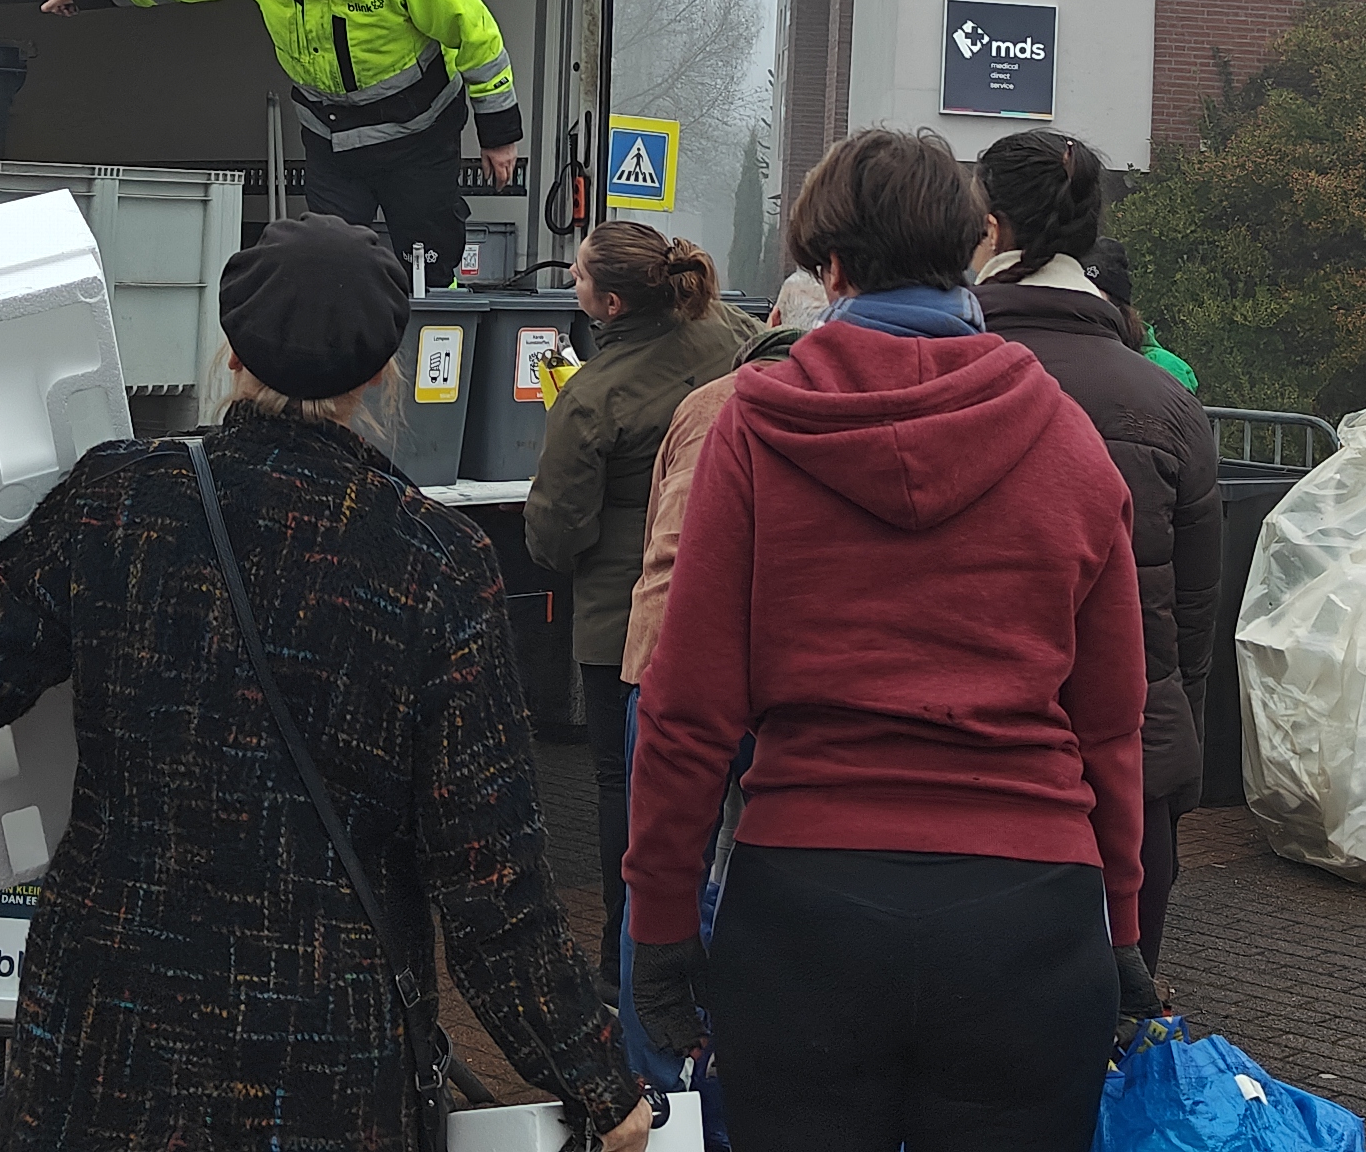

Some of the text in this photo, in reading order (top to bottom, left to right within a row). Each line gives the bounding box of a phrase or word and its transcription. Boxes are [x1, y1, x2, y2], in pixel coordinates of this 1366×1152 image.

[347, 2, 373, 13] blink
[991, 36, 1046, 60] mds
[990, 62, 1019, 70] medical
[990, 71, 1011, 80] direct
[990, 82, 1015, 90] service
[1, 894, 24, 906] DAN
